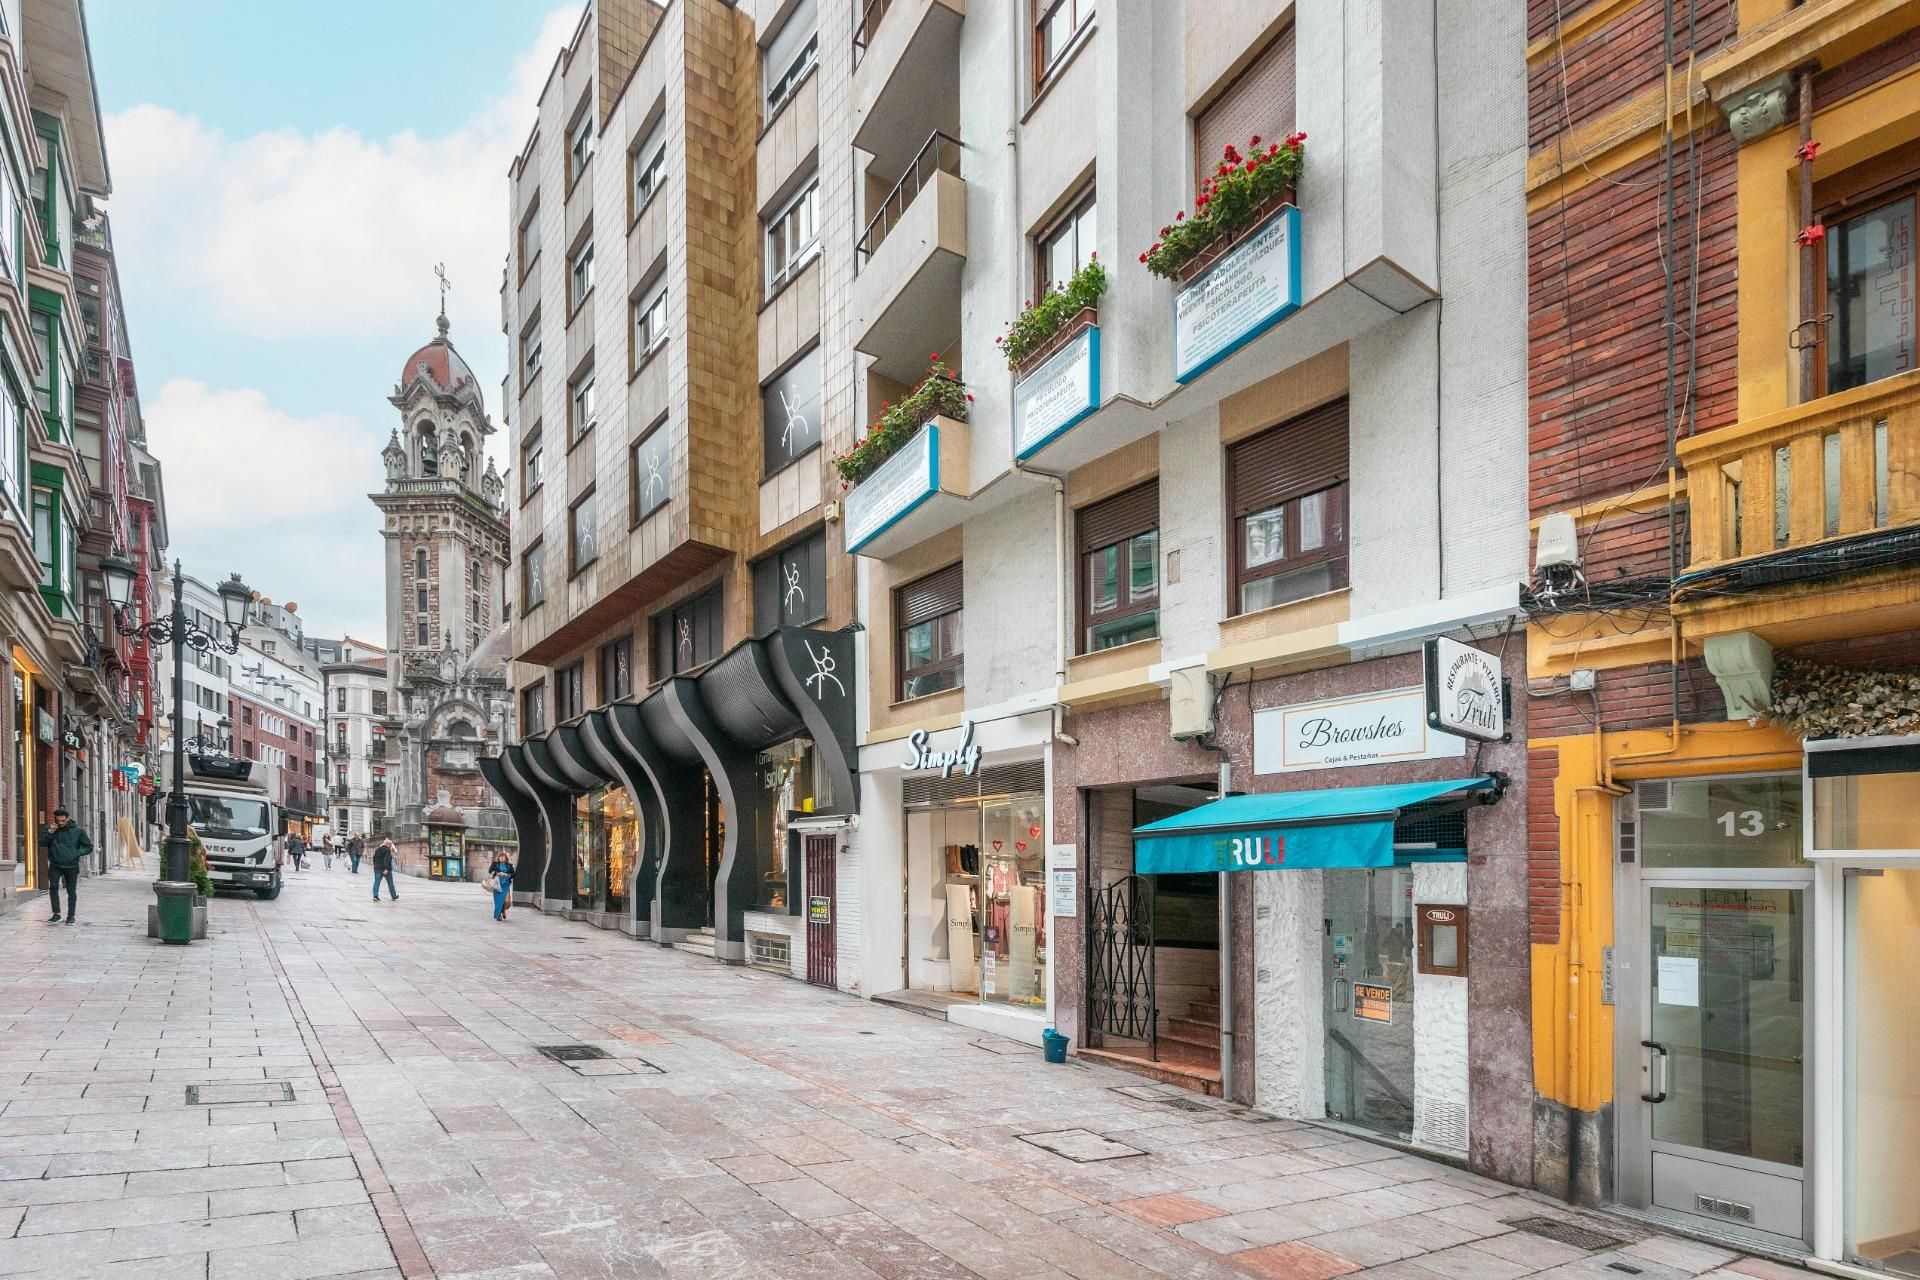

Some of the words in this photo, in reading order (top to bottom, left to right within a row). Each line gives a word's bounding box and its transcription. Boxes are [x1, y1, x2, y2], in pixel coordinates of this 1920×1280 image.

[1214, 224, 1280, 280] ADOLESCENTES
[1178, 294, 1206, 320] VICENTE
[1206, 262, 1248, 299] FERNÁNDEZ
[1249, 232, 1286, 266] VÁZQUEZ
[1205, 270, 1253, 312] PSICÓLOGO
[1192, 275, 1267, 335] PSICOTERAPEUTA
[1447, 652, 1479, 691] RESTAURANTE
[1451, 687, 1497, 730] Truli
[899, 719, 982, 779] Simply
[1299, 714, 1407, 749] Browshes
[1348, 752, 1380, 761] Pestañas
[1716, 810, 1765, 837] 13
[205, 844, 235, 853] VECO
[1214, 835, 1286, 866] TRULI
[1431, 911, 1450, 920] TRULI
[1354, 985, 1365, 997] SE
[1365, 987, 1390, 1000] VENDE
